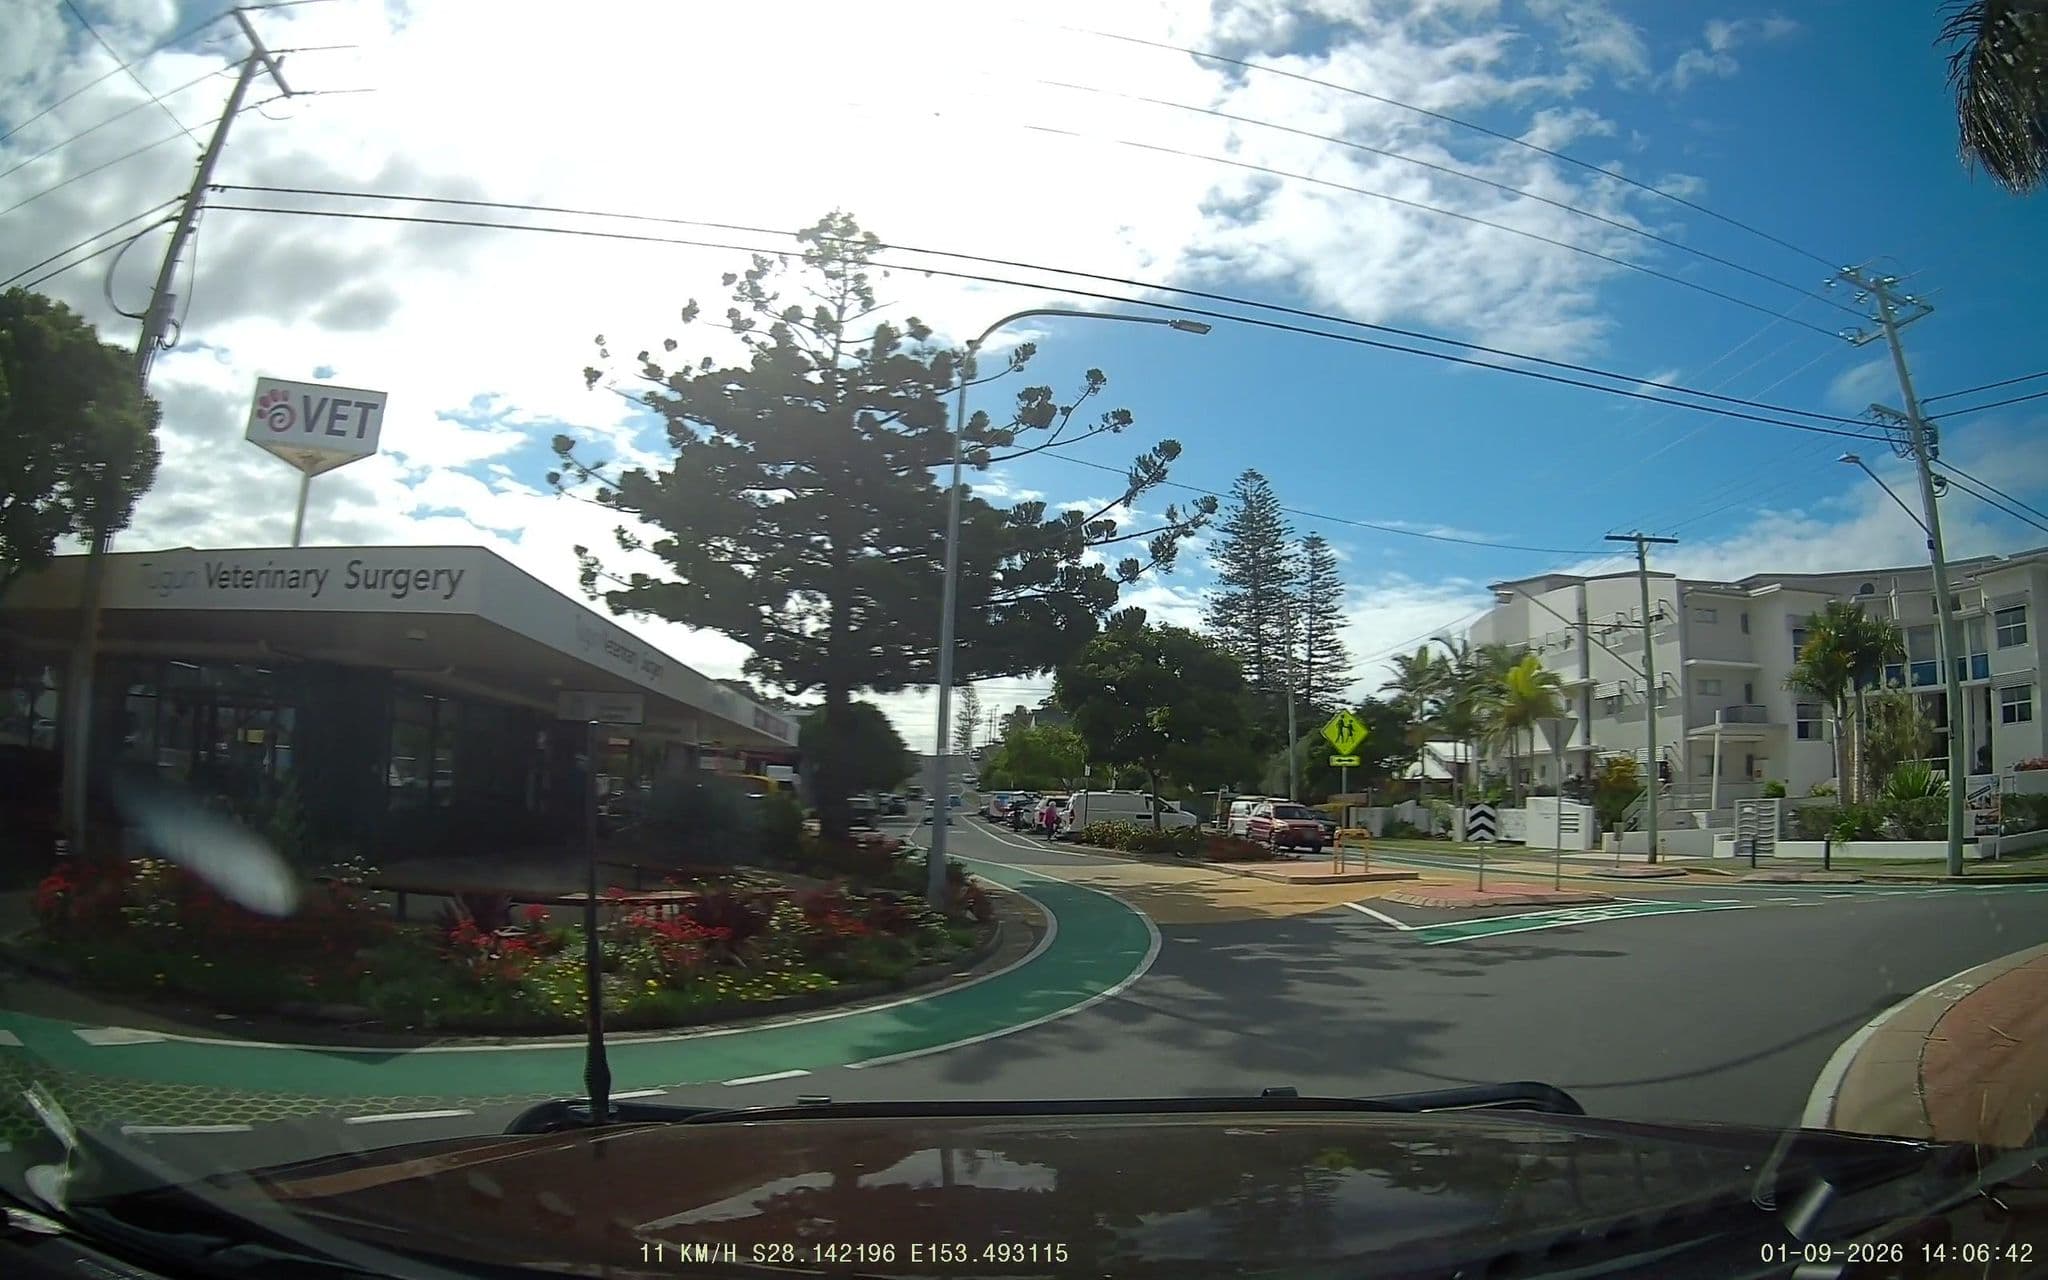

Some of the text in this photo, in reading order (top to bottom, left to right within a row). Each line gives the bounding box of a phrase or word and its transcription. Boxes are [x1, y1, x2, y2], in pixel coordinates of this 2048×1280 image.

[303, 395, 379, 439] VET
[205, 560, 331, 598] Veterinary
[344, 559, 465, 600] Surgery
